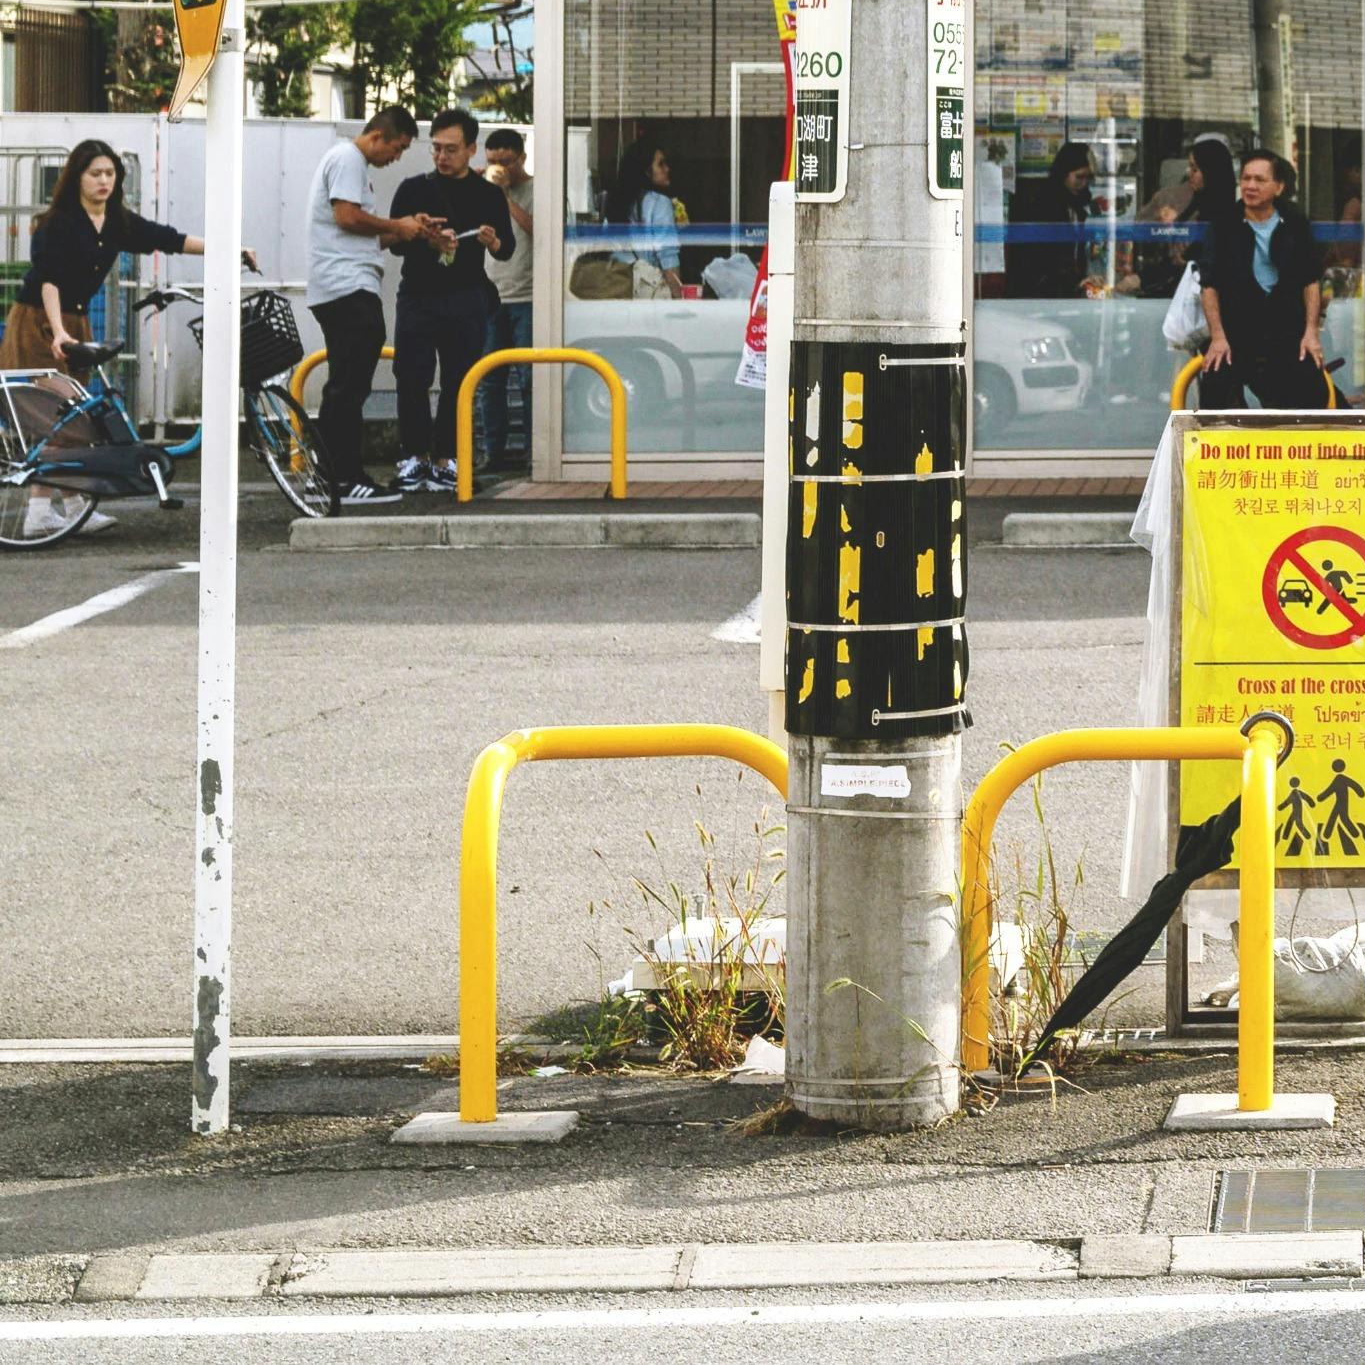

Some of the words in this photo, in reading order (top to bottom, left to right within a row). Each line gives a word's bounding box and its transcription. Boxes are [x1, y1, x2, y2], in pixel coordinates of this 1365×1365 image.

[933, 21, 964, 45] 055
[940, 111, 964, 139] 富士
[1200, 442, 1221, 461] Do
[1226, 442, 1251, 461] not
[1256, 442, 1283, 461] run
[1288, 442, 1313, 461] out
[1317, 442, 1347, 461] into
[1197, 469, 1320, 491] 請勿衝出車道
[1233, 497, 1279, 517] 찻길로
[1285, 497, 1362, 516] 뛰쳐나오지
[1237, 677, 1276, 695] Cross
[1281, 677, 1297, 695] at
[1301, 677, 1325, 695] the
[1321, 732, 1351, 750] 건너
